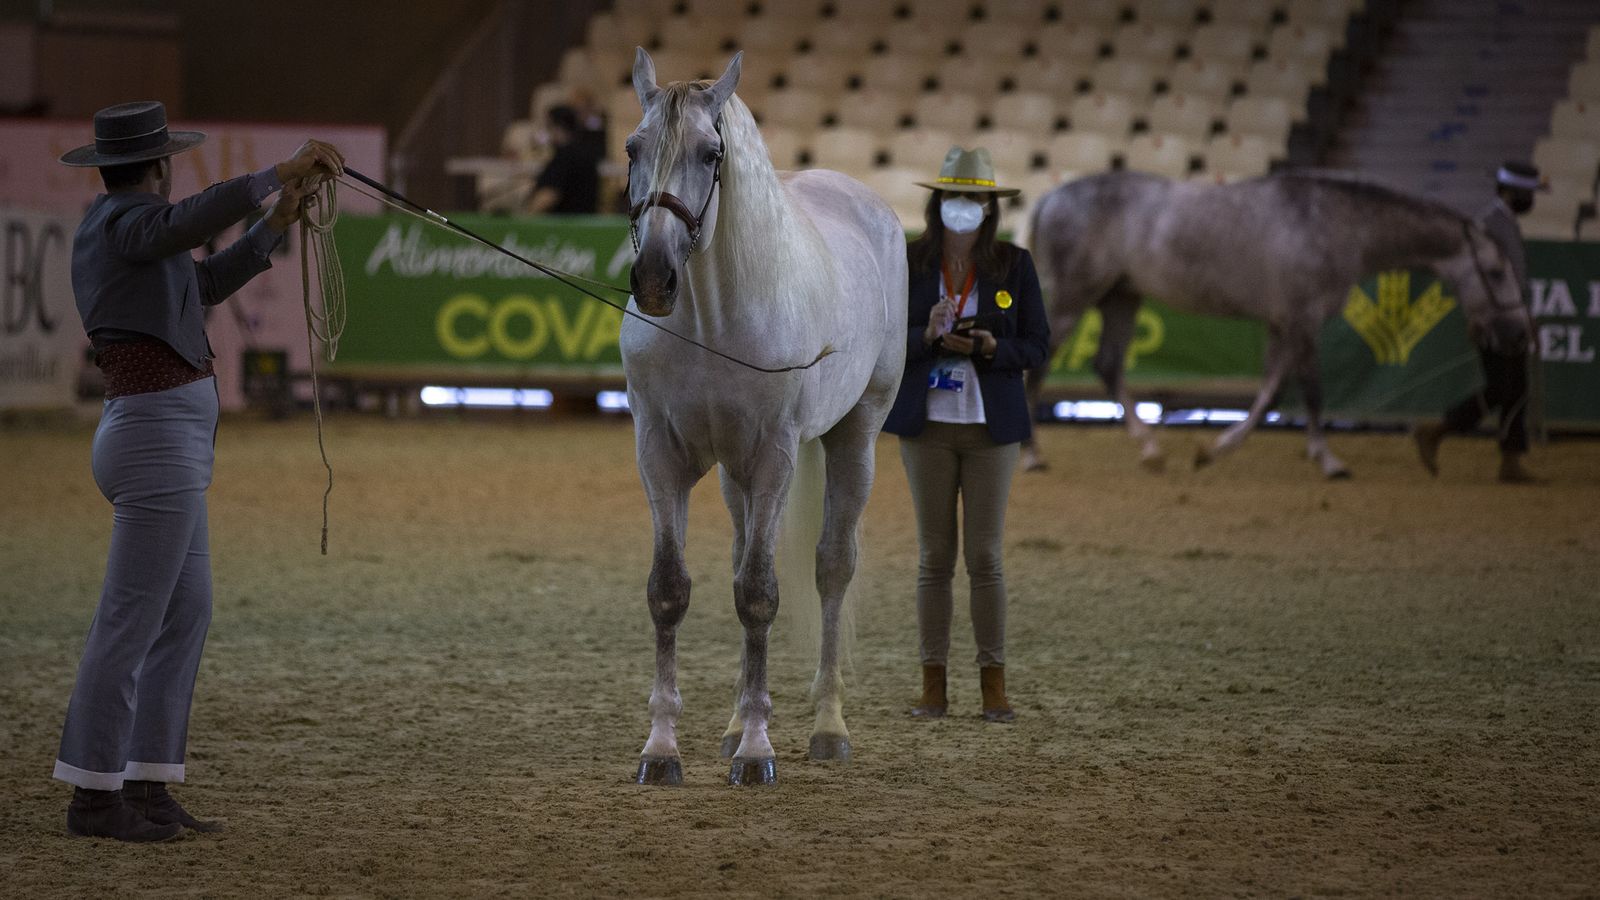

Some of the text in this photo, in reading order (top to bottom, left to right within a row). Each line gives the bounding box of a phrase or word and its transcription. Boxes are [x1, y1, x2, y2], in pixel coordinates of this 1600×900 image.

[2, 218, 66, 336] BC
[434, 292, 624, 360] COVA
[1538, 323, 1596, 364] EL
